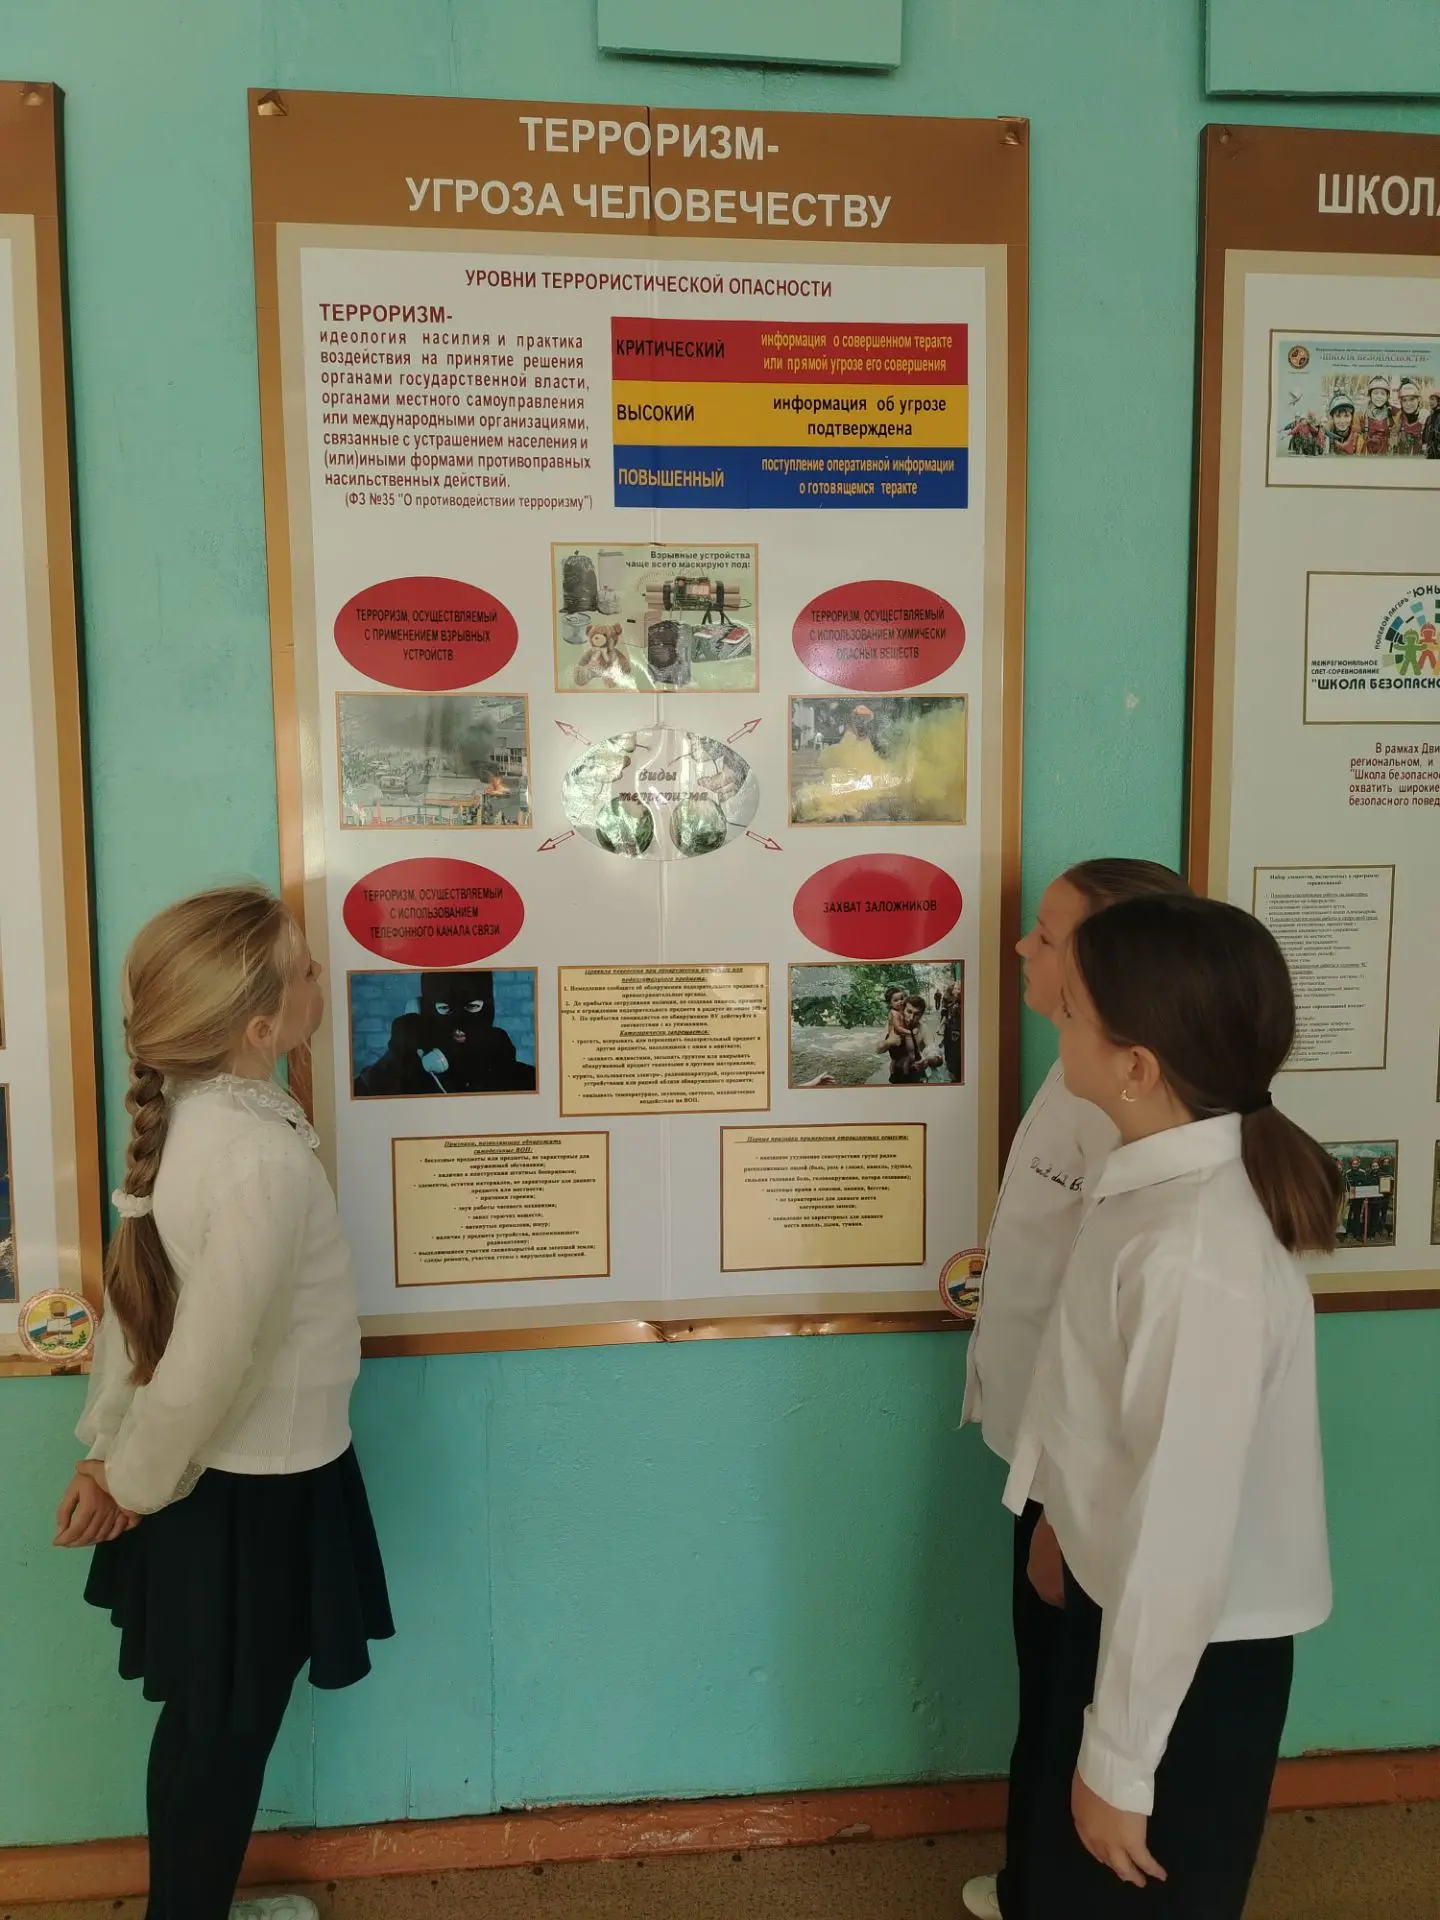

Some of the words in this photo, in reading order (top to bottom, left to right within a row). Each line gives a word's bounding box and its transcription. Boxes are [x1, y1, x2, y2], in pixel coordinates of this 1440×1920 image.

[519, 116, 779, 160] ТЕРРОРИЗМ-
[405, 177, 564, 216] УГРОЗА
[573, 183, 891, 228] ЧЕЛОВЕЧЕСТВУ
[1318, 173, 1440, 216] ШКОЛ
[465, 269, 537, 288] УРОВНИ
[541, 271, 724, 294] ТЕРРОРИСТИЧЕСКОЙ
[729, 278, 832, 298] ОПАСНОСТИ
[319, 303, 453, 323] ТЕРРОРИЗМ-
[320, 330, 407, 346] идеология
[422, 331, 490, 346] насилия
[498, 334, 506, 346] и
[516, 334, 583, 351] практика
[616, 338, 725, 358] КРИТИЧЕСКИЙ
[761, 332, 827, 350] информация
[833, 335, 840, 348] о
[842, 334, 912, 352] совершенном
[914, 336, 953, 349] теракте
[321, 348, 411, 366] воздействия
[421, 353, 438, 365] на
[446, 354, 514, 369] принятие
[523, 355, 584, 371] решения
[763, 357, 783, 371] или
[787, 354, 828, 373] прямой
[831, 359, 863, 374] угрозе
[865, 359, 882, 373] его
[884, 359, 946, 375] совершения
[321, 371, 392, 387] органами
[400, 372, 527, 389] государственной
[534, 375, 590, 391] власти,
[322, 392, 390, 407] органами
[396, 393, 460, 406] местного
[466, 395, 585, 411] самоуправления
[773, 396, 867, 414] информация
[877, 395, 895, 411] об
[899, 399, 947, 415] угрозе
[617, 402, 695, 422] ВЫСОКИЙ
[323, 413, 348, 425] или
[352, 414, 475, 429] международными
[479, 415, 589, 431] организациями,
[808, 422, 913, 439] подтверждена
[323, 433, 399, 446] связанные
[403, 434, 410, 446] с
[414, 434, 503, 450] устрашением
[507, 436, 577, 449] населения
[580, 438, 588, 449] и
[410, 452, 473, 470] формами
[478, 455, 591, 471] противоправных
[761, 458, 824, 476] поступление
[827, 456, 890, 475] оперативной
[892, 458, 955, 476] информации
[325, 473, 440, 487] насильственных
[443, 473, 510, 489] действий.
[618, 466, 725, 488] ПОВЫШЕННЫЙ
[799, 482, 806, 494] о
[808, 482, 875, 497] готовящемся
[881, 481, 918, 496] теракте
[345, 491, 366, 508] (ФЗ
[369, 492, 395, 507] №35
[415, 494, 515, 510] противодействии
[650, 551, 698, 560] Взрывные
[700, 551, 750, 561] устройства
[625, 561, 649, 569] чаще
[651, 561, 677, 569] всего
[678, 561, 729, 570] маскируют
[731, 561, 750, 569] под:
[356, 608, 410, 623] ТЕРРОРИЗМ,
[412, 609, 498, 623] ОСУЩЕСТВЛЯЕМЫЙ
[811, 610, 862, 623] ТЕРРОРИЗМ,
[864, 607, 945, 623] ОСУЩЕСТВЛЯЕМЫЙ
[364, 628, 370, 641] С
[372, 628, 439, 642] ПРИМЕНЕНИЕМ
[440, 629, 491, 642] ВЗРЫВНЫХ
[809, 629, 815, 641] С
[403, 647, 454, 661] УСТРОЙСТВ
[1311, 678, 1366, 689] "ШКОЛА
[1375, 742, 1382, 753] В
[1385, 745, 1419, 756] рамках
[1428, 759, 1434, 767] и
[1350, 769, 1386, 780] "Школа
[1388, 769, 1440, 780] безопасно
[1349, 784, 1392, 793] охватить
[1399, 784, 1440, 796] широкие
[1349, 795, 1409, 806] безопасного
[420, 887, 503, 901] ОСУЩЕСТВЛЯЕМЫЙ
[390, 907, 396, 919] С
[398, 906, 479, 919] ИСПОЛЬЗОВАНИЕМ
[823, 901, 861, 914] ЗАХВАТ
[865, 900, 937, 913] ЗАЛОЖНИКОВ
[370, 924, 434, 939] ТЕЛЕФОННОГО
[436, 925, 470, 937] КАНАЛА
[471, 923, 500, 936] СВЯЗИ
